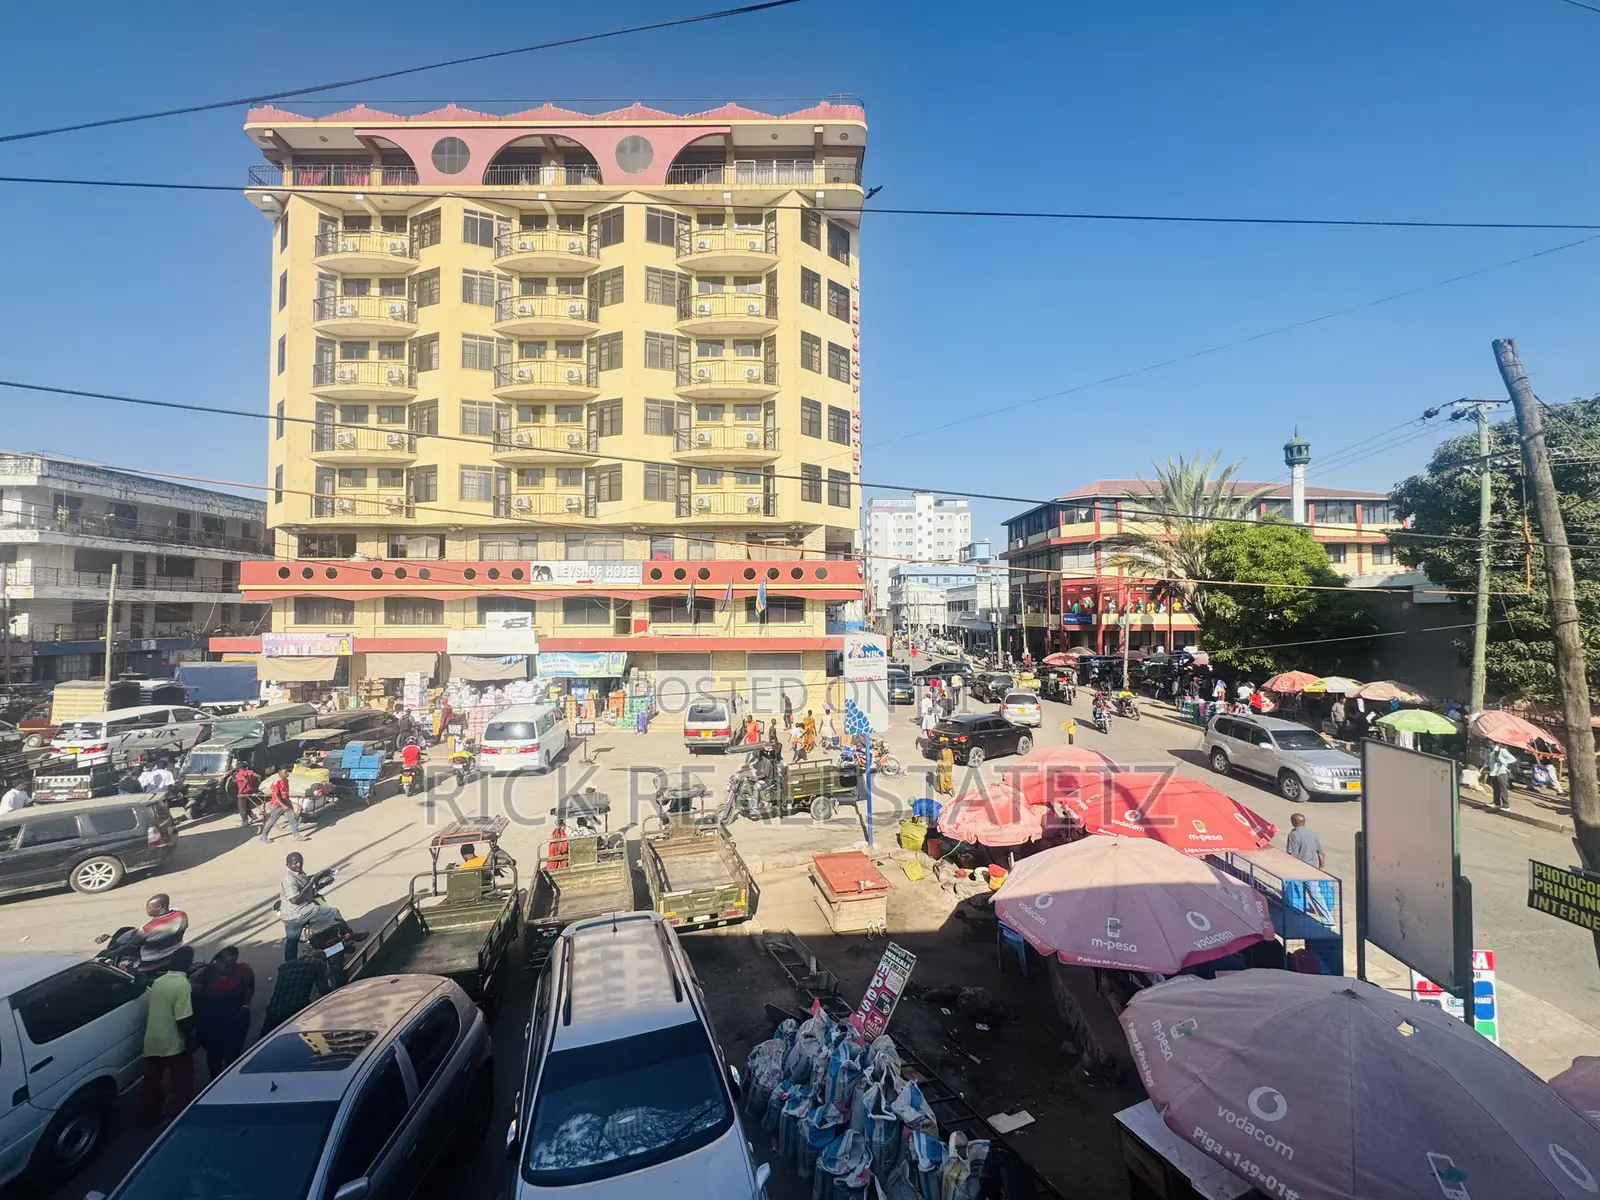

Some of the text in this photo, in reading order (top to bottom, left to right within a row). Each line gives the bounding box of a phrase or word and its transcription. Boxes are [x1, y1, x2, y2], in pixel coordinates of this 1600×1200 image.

[852, 409, 861, 475] HOTEL
[556, 563, 641, 578] LEYSHOF HOTEL
[865, 650, 884, 658] NBC
[1111, 818, 1146, 832] vodacom
[1188, 834, 1223, 843] m-pesa
[1018, 901, 1047, 926] vodacom
[1091, 937, 1138, 953] m-pesa
[1194, 929, 1234, 949] vodacom
[885, 949, 911, 970] WAKALA
[1077, 956, 1102, 964] Pakua
[1473, 997, 1492, 1005] NMB
[1151, 1019, 1174, 1062] m-pesa
[1134, 1042, 1149, 1071] M-Pesa
[1144, 1069, 1154, 1088] App
[1216, 1105, 1295, 1161] vodacom
